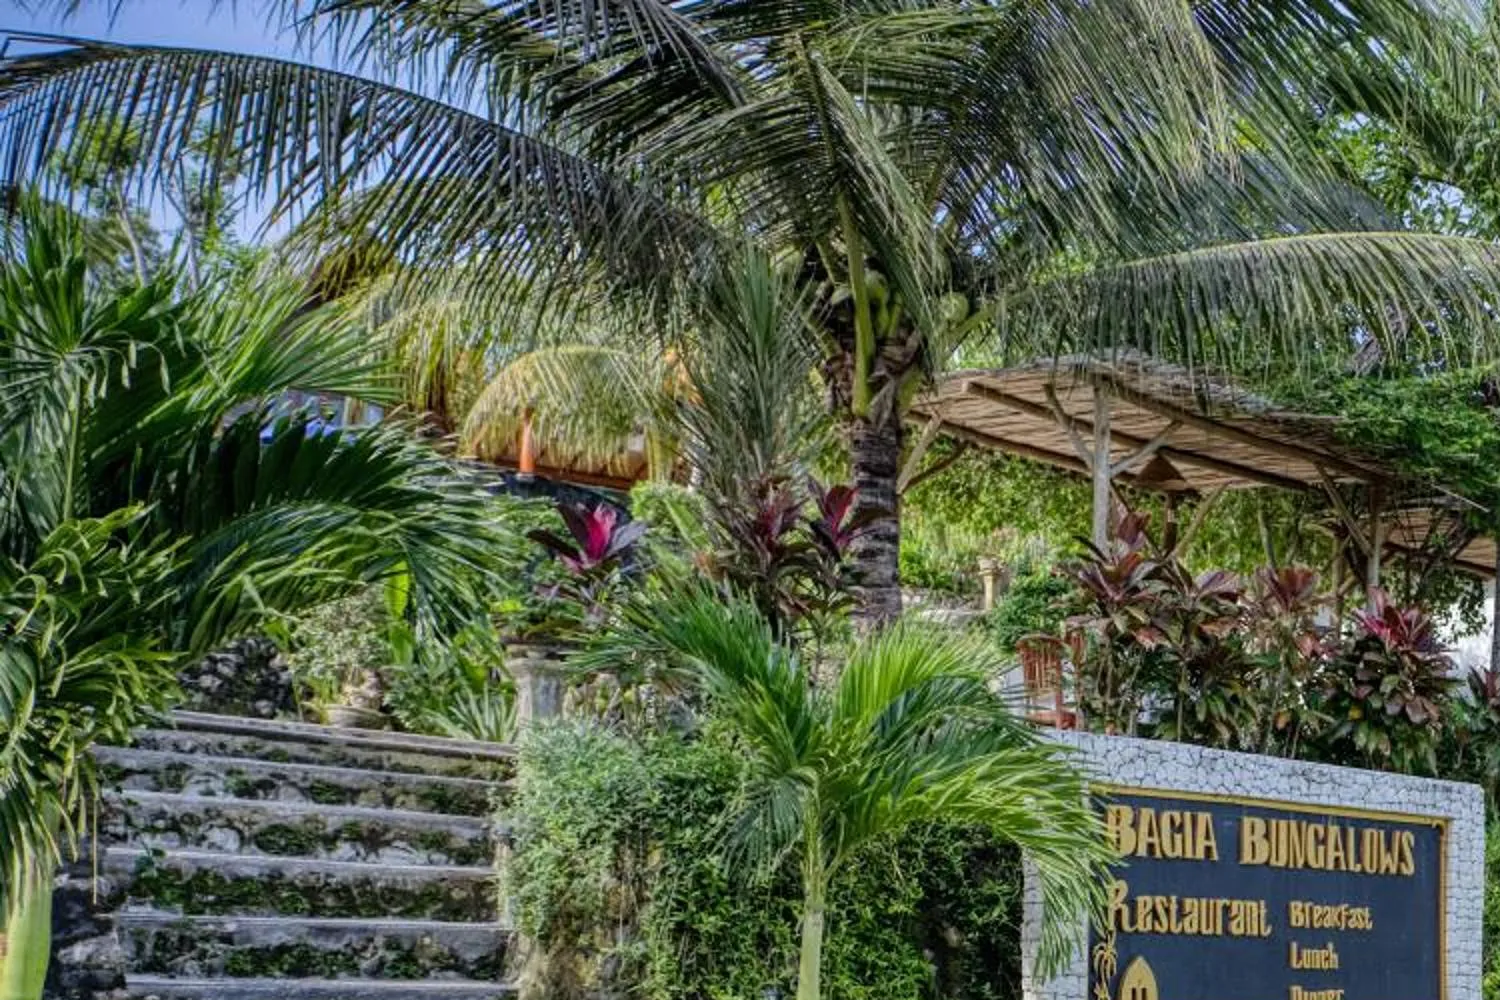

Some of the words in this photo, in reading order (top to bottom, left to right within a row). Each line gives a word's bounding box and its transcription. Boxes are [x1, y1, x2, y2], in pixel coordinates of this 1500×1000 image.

[1106, 804, 1219, 861] BAGIA
[1240, 816, 1416, 877] BUNGALOWS
[1108, 879, 1272, 937] Restaurant
[1290, 941, 1339, 969] Lunch
